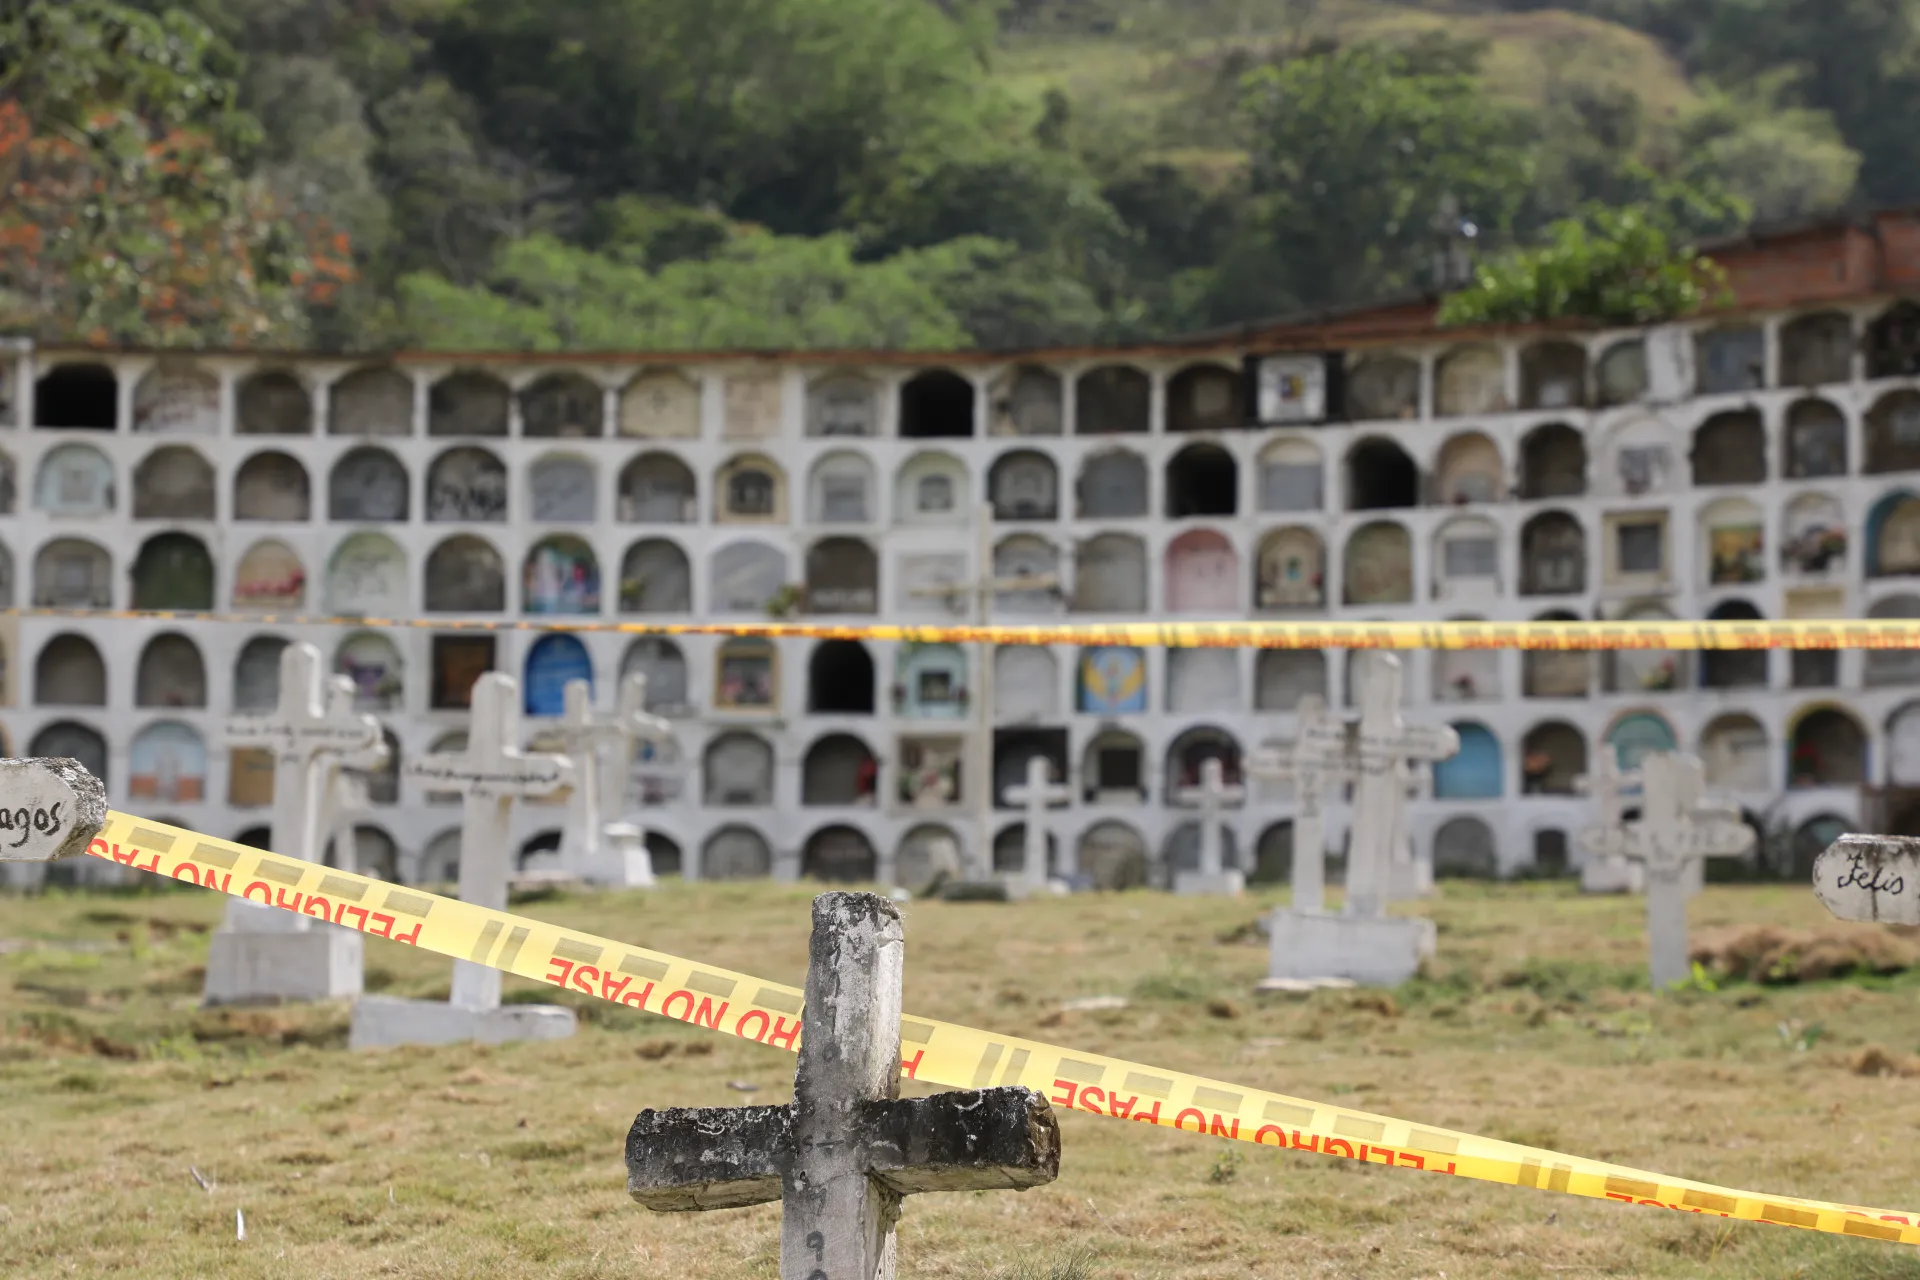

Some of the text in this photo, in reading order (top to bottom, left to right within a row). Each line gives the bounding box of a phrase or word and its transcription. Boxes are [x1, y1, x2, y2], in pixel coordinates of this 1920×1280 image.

[85, 838, 161, 873] PAS
[172, 862, 232, 894] NO
[545, 957, 655, 1011] PASE
[661, 990, 730, 1031] NO
[1051, 1079, 1161, 1126] PASE
[1174, 1108, 1240, 1140] NO
